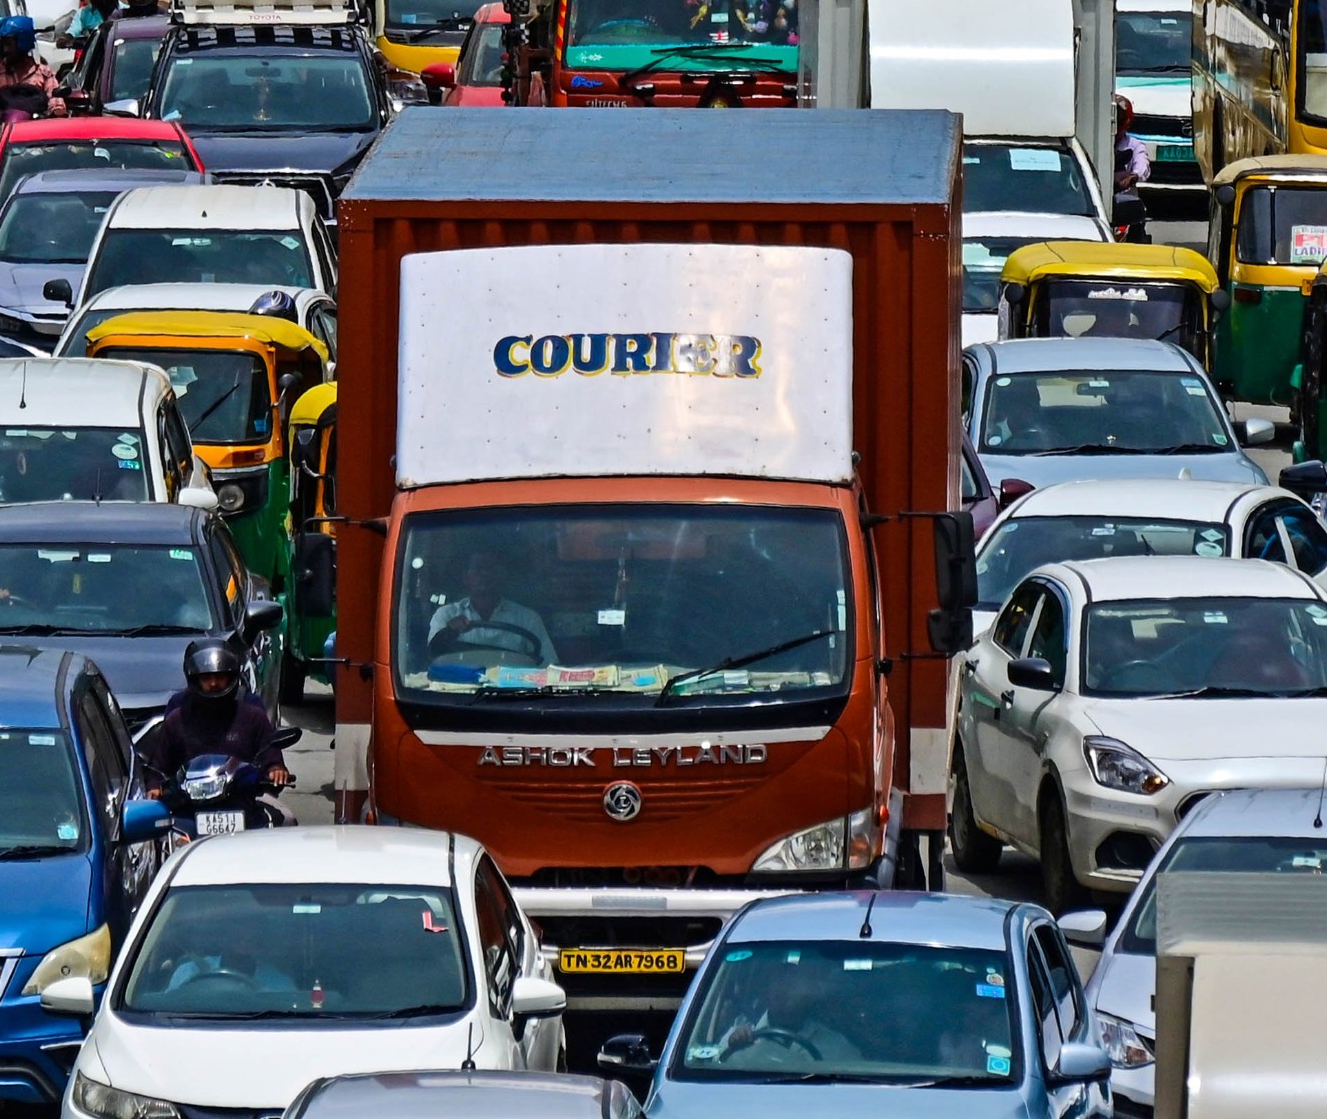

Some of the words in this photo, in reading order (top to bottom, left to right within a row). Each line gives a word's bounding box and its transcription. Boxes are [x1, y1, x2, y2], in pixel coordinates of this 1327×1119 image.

[493, 332, 763, 378] COURIER
[477, 745, 596, 767] ASHOK
[612, 744, 768, 767] LEYLAND
